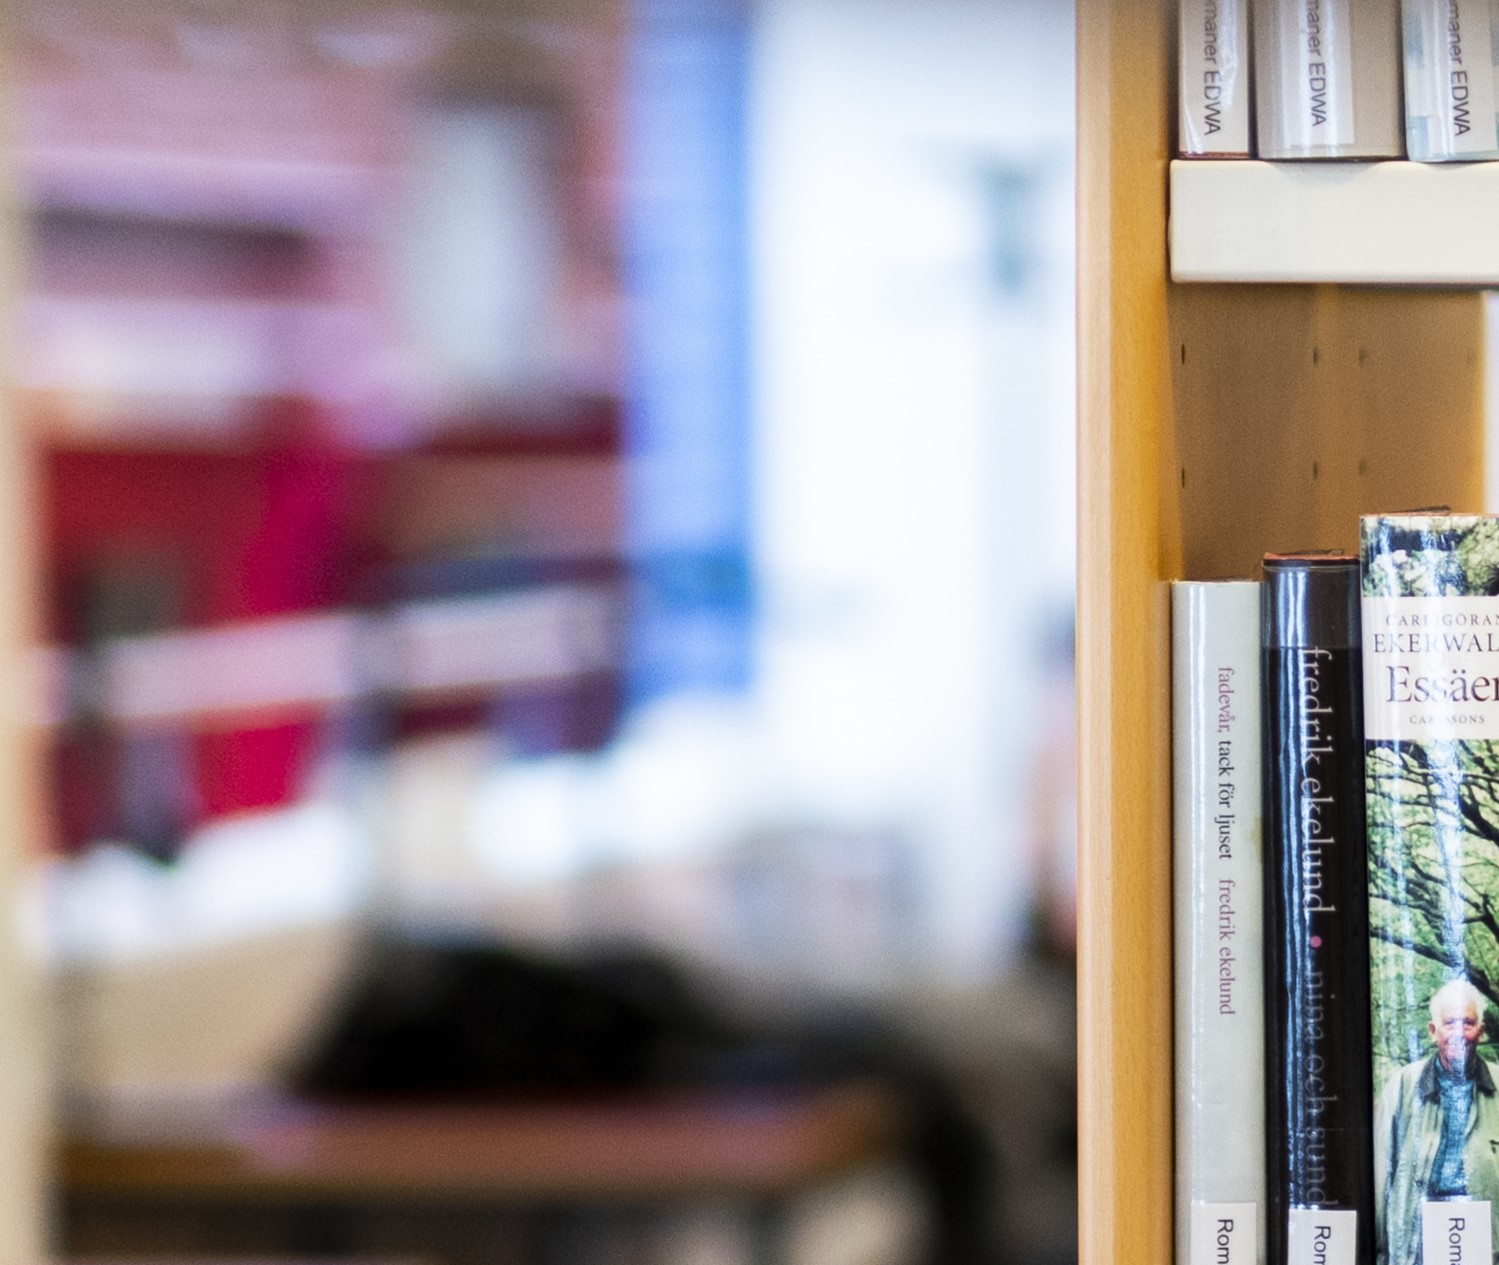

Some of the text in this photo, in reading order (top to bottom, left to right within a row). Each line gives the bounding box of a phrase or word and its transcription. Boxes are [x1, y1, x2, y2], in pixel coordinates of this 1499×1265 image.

[1204, 73, 1222, 137] EDWA
[1214, 666, 1236, 1015] fadevår, tack för ljuset fredrik ekelund
